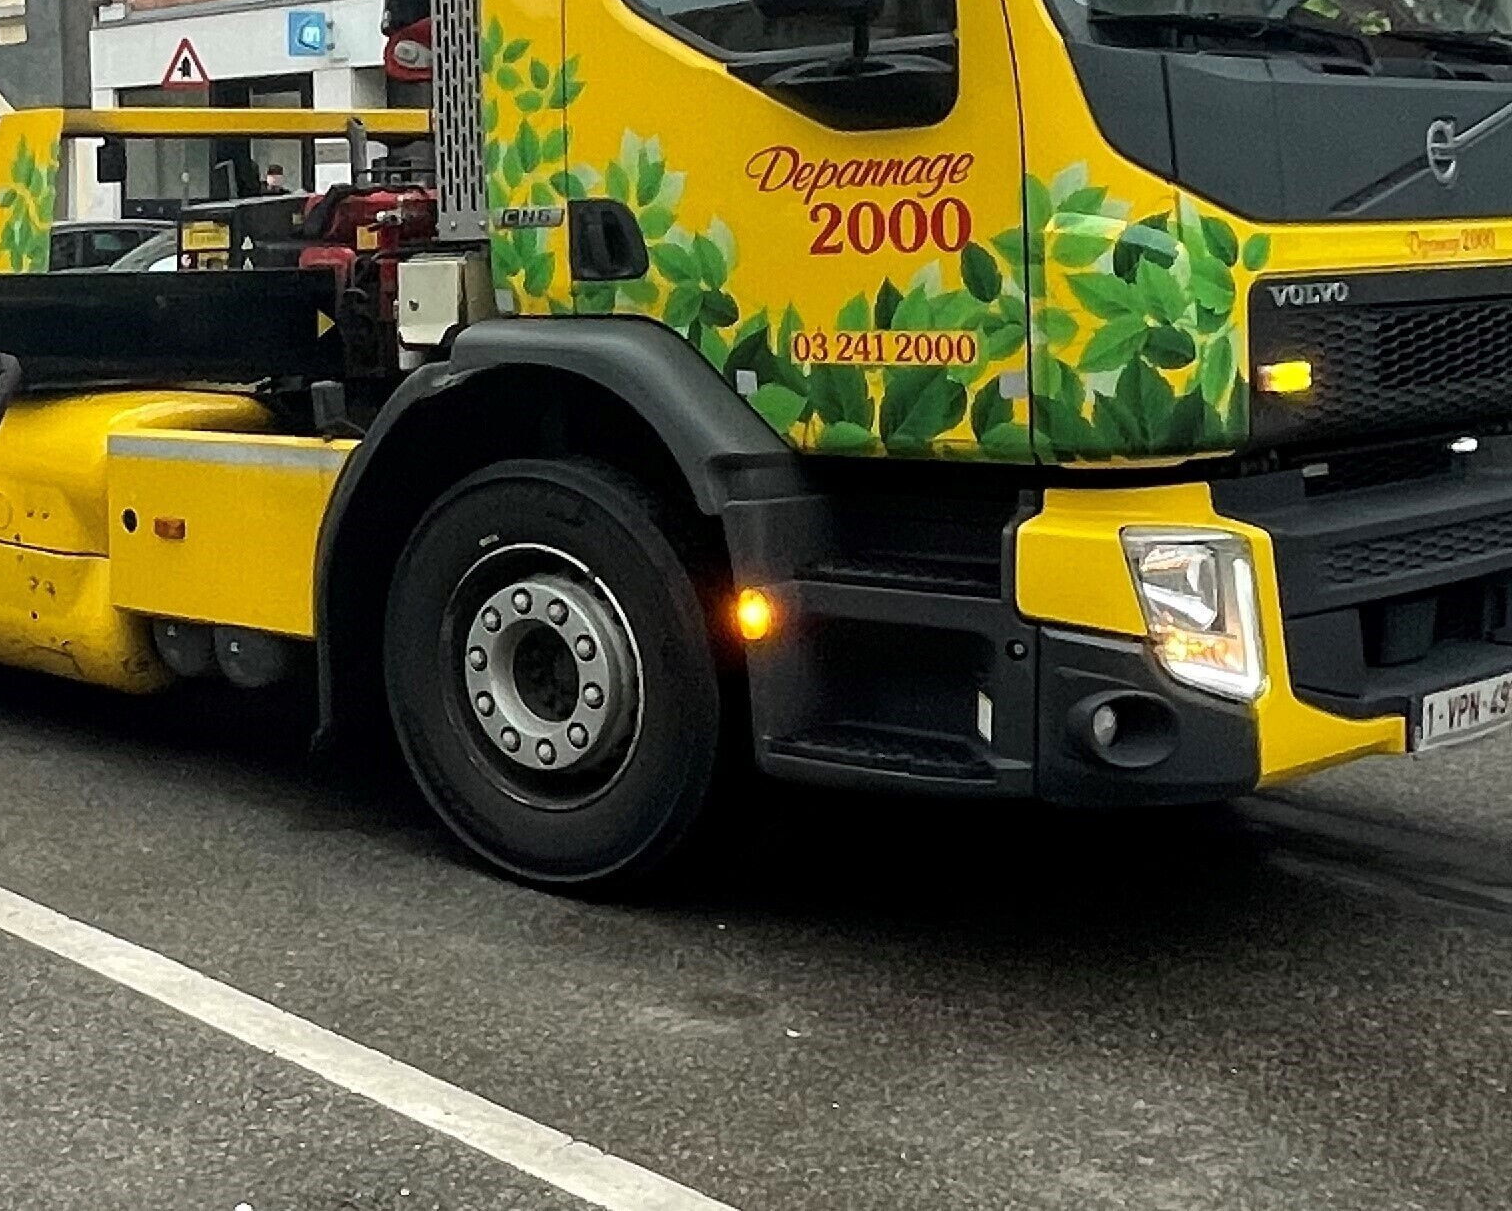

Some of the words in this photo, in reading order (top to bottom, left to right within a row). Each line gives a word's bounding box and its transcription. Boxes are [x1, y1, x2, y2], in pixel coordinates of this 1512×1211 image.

[744, 145, 975, 205] Depannage
[808, 197, 973, 255] 2000
[1268, 281, 1350, 308] VOLVO
[793, 330, 829, 363] 03
[835, 331, 886, 363] 241
[894, 332, 977, 365] 2000
